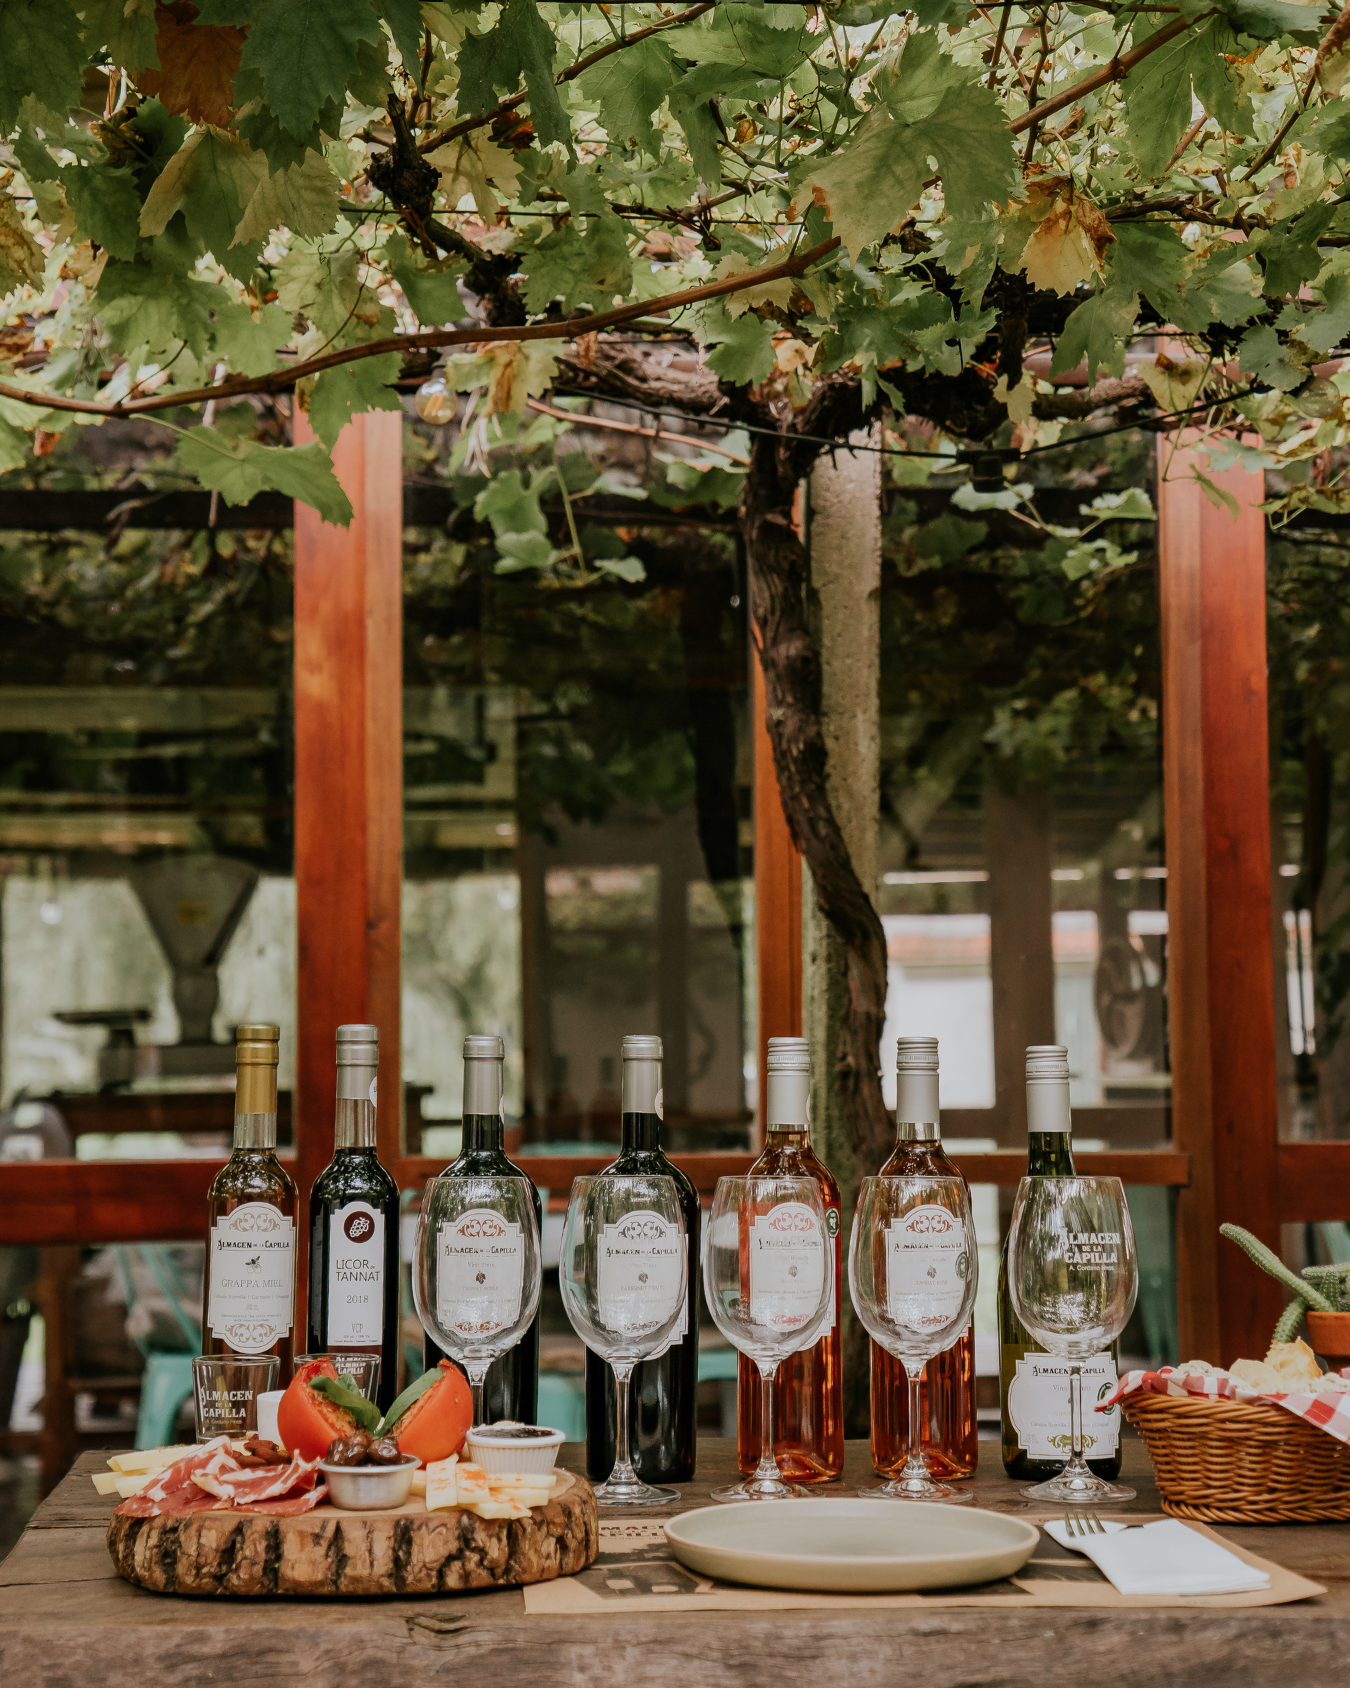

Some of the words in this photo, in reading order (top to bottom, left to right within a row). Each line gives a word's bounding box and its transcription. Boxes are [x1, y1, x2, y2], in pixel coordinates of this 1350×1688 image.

[1058, 1227, 1121, 1251] ALMACEN
[217, 1239, 252, 1251] ALMACEN
[264, 1240, 290, 1249] CAPILLA
[491, 1245, 517, 1254] CAPILLA
[1065, 1252, 1118, 1264] CAPILLA
[336, 1259, 370, 1270] LICOR
[335, 1270, 381, 1282] TANNAT
[221, 1279, 259, 1288] GRAPPA
[262, 1279, 284, 1288] MIEL
[346, 1295, 369, 1304] 2018
[351, 1323, 364, 1334] VCP
[1031, 1365, 1069, 1376] ALMACEN
[200, 1386, 254, 1406] ALMACEN
[203, 1407, 247, 1418] CAPILLA
